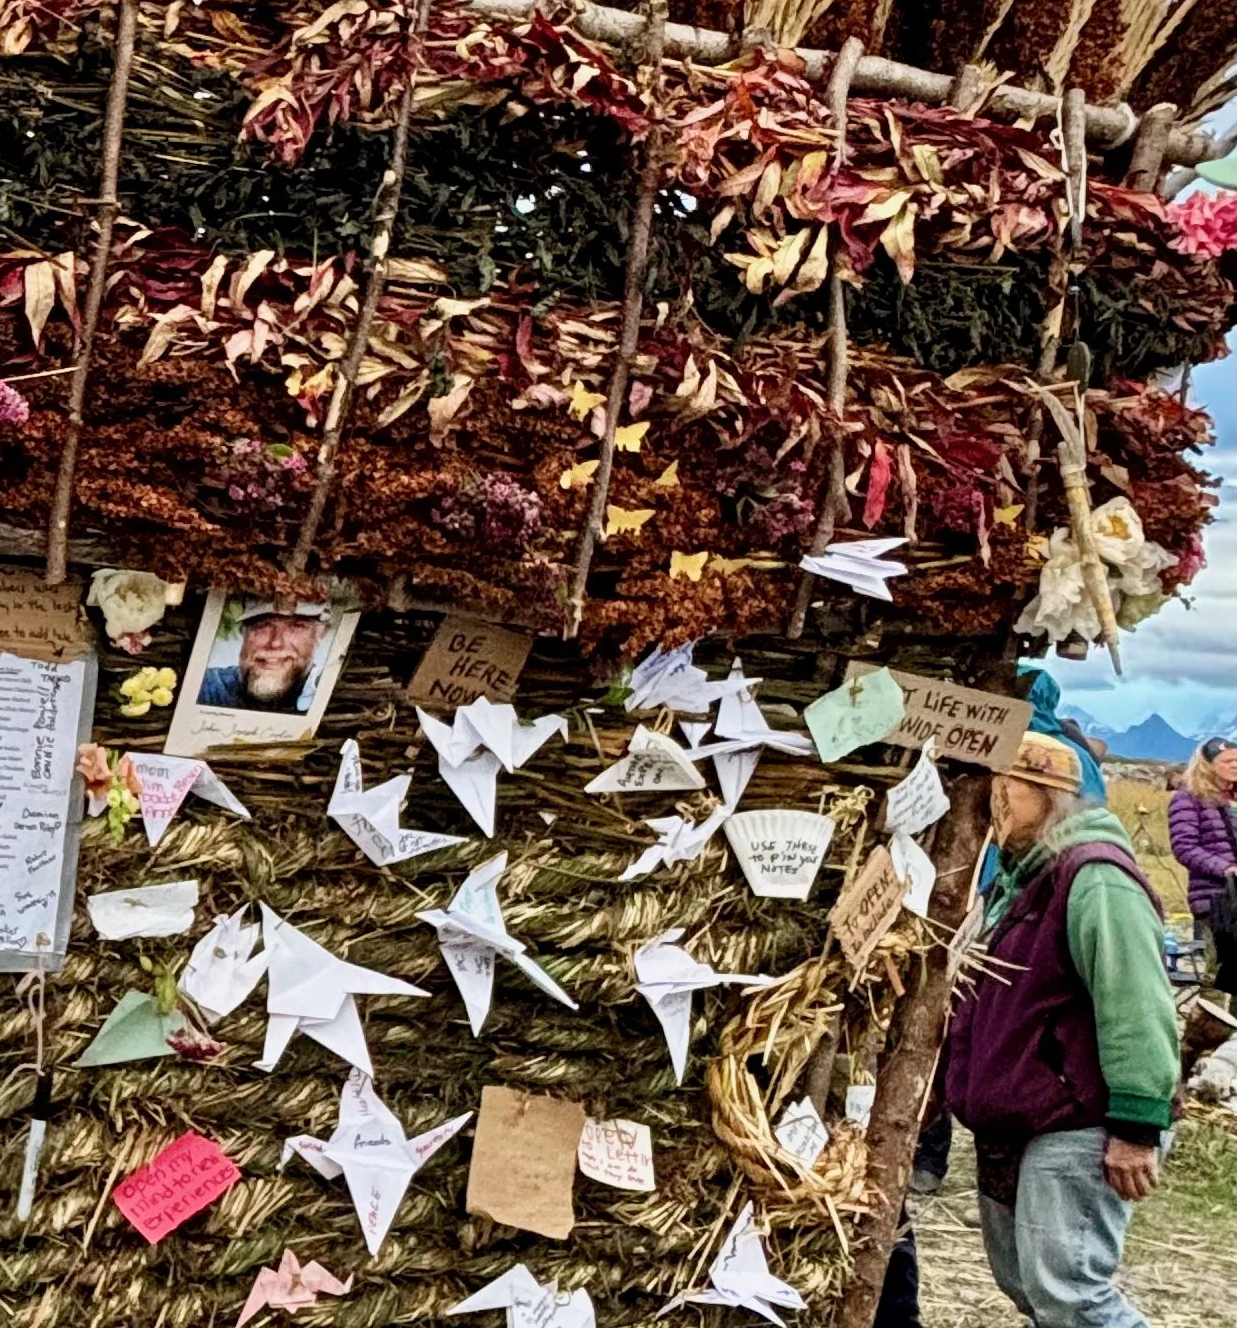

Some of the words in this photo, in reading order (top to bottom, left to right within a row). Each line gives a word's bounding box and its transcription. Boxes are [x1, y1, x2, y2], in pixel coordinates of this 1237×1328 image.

[13, 626, 26, 639] to
[448, 632, 487, 653] BE
[449, 654, 512, 691] HERE
[428, 678, 486, 704] NOW
[945, 723, 1000, 758] OPEN
[750, 840, 777, 851] USE
[130, 1183, 175, 1219] mind
[172, 1173, 192, 1191] to
[143, 1164, 236, 1231] experiences
